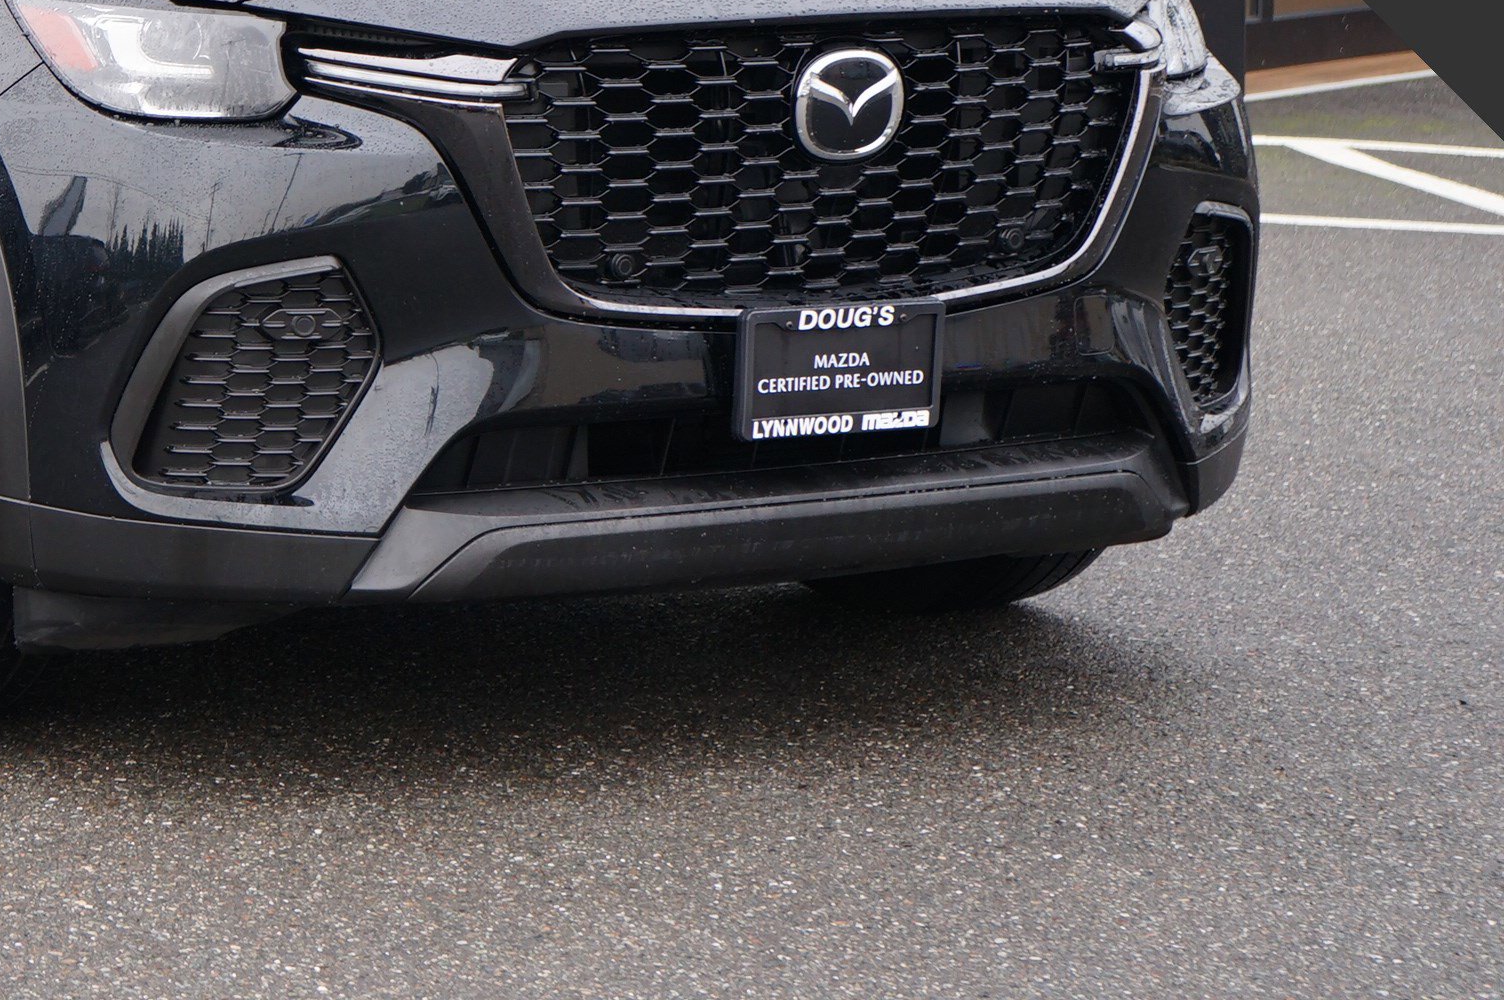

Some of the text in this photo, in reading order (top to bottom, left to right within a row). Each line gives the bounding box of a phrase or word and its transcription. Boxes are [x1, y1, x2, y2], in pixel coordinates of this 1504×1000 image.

[798, 306, 895, 331] DOUG'S
[814, 353, 870, 369] MAZDA
[758, 370, 924, 394] CERTIFIED PRE-OWNED
[752, 415, 853, 439] LYNNWOOD
